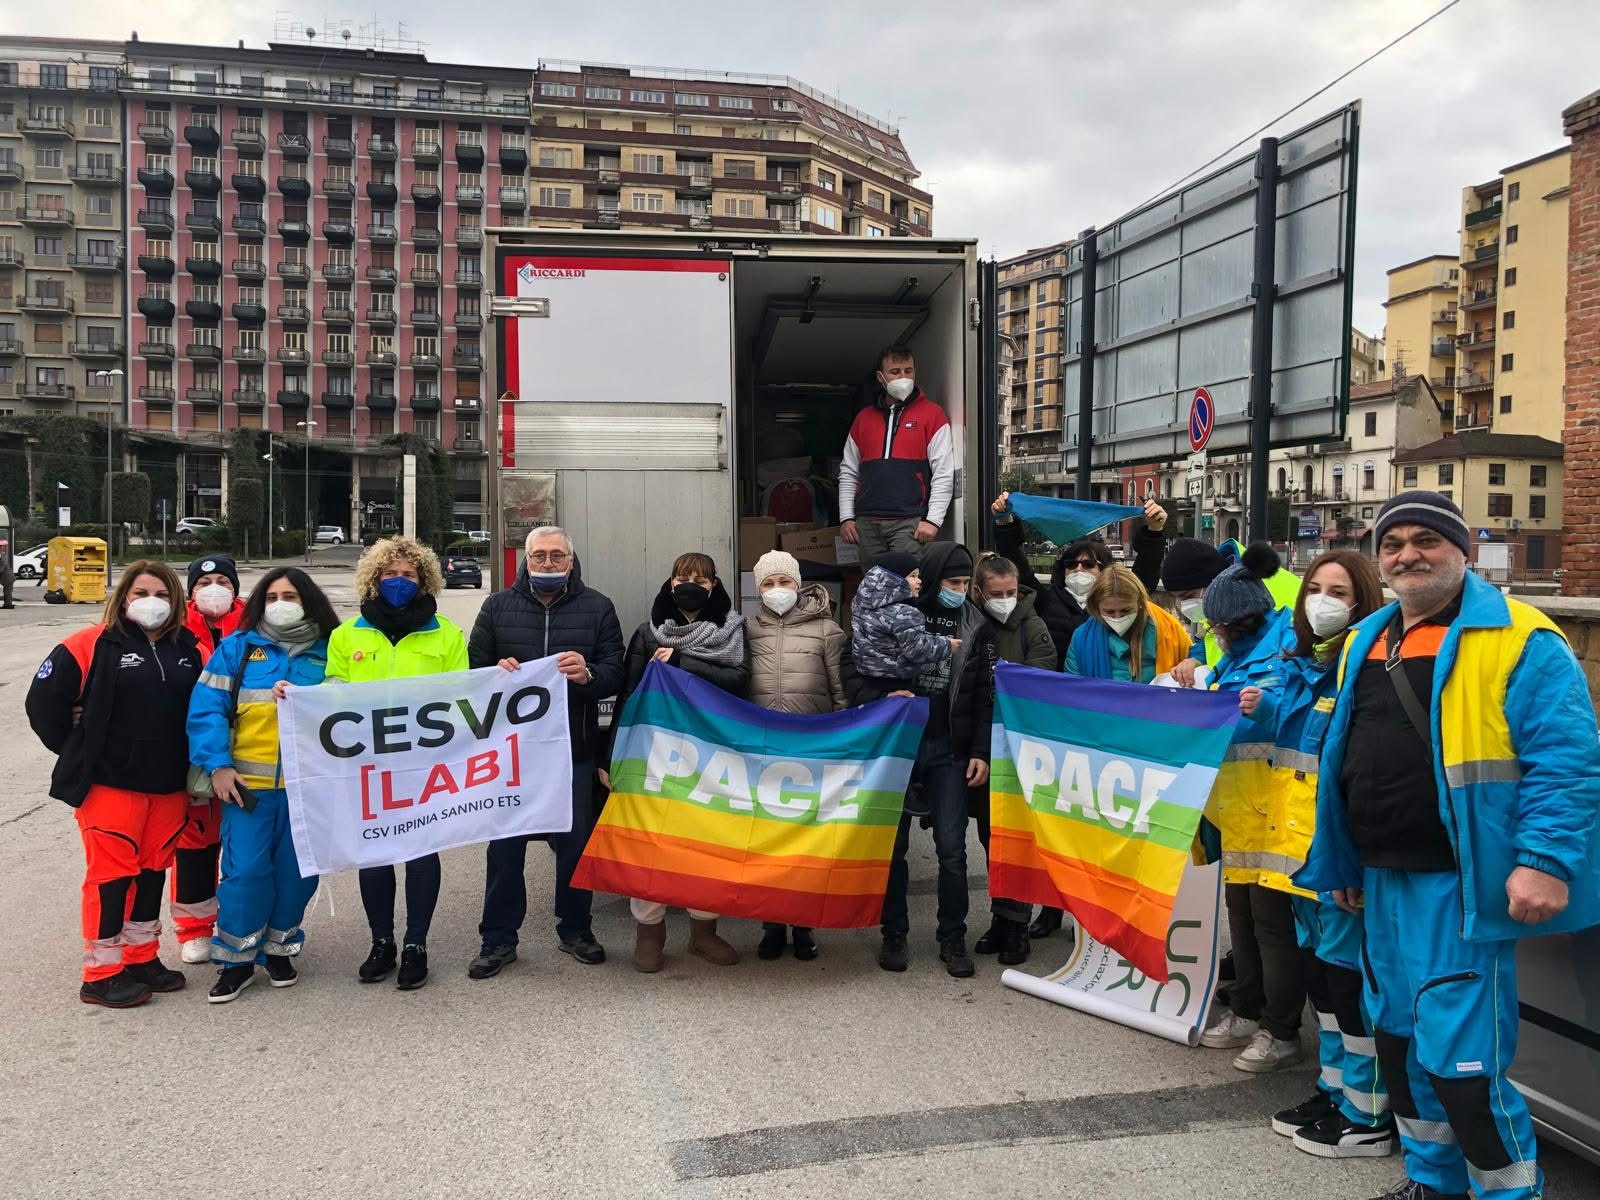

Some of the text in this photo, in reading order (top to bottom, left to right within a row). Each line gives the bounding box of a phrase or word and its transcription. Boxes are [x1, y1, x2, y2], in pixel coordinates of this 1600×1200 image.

[530, 269, 585, 278] RICCARDI
[319, 685, 551, 758] CESVO
[360, 733, 521, 820] [LAB]
[643, 731, 864, 822] PACE
[362, 795, 521, 840] CSV IRPINIA SANNIO ETS
